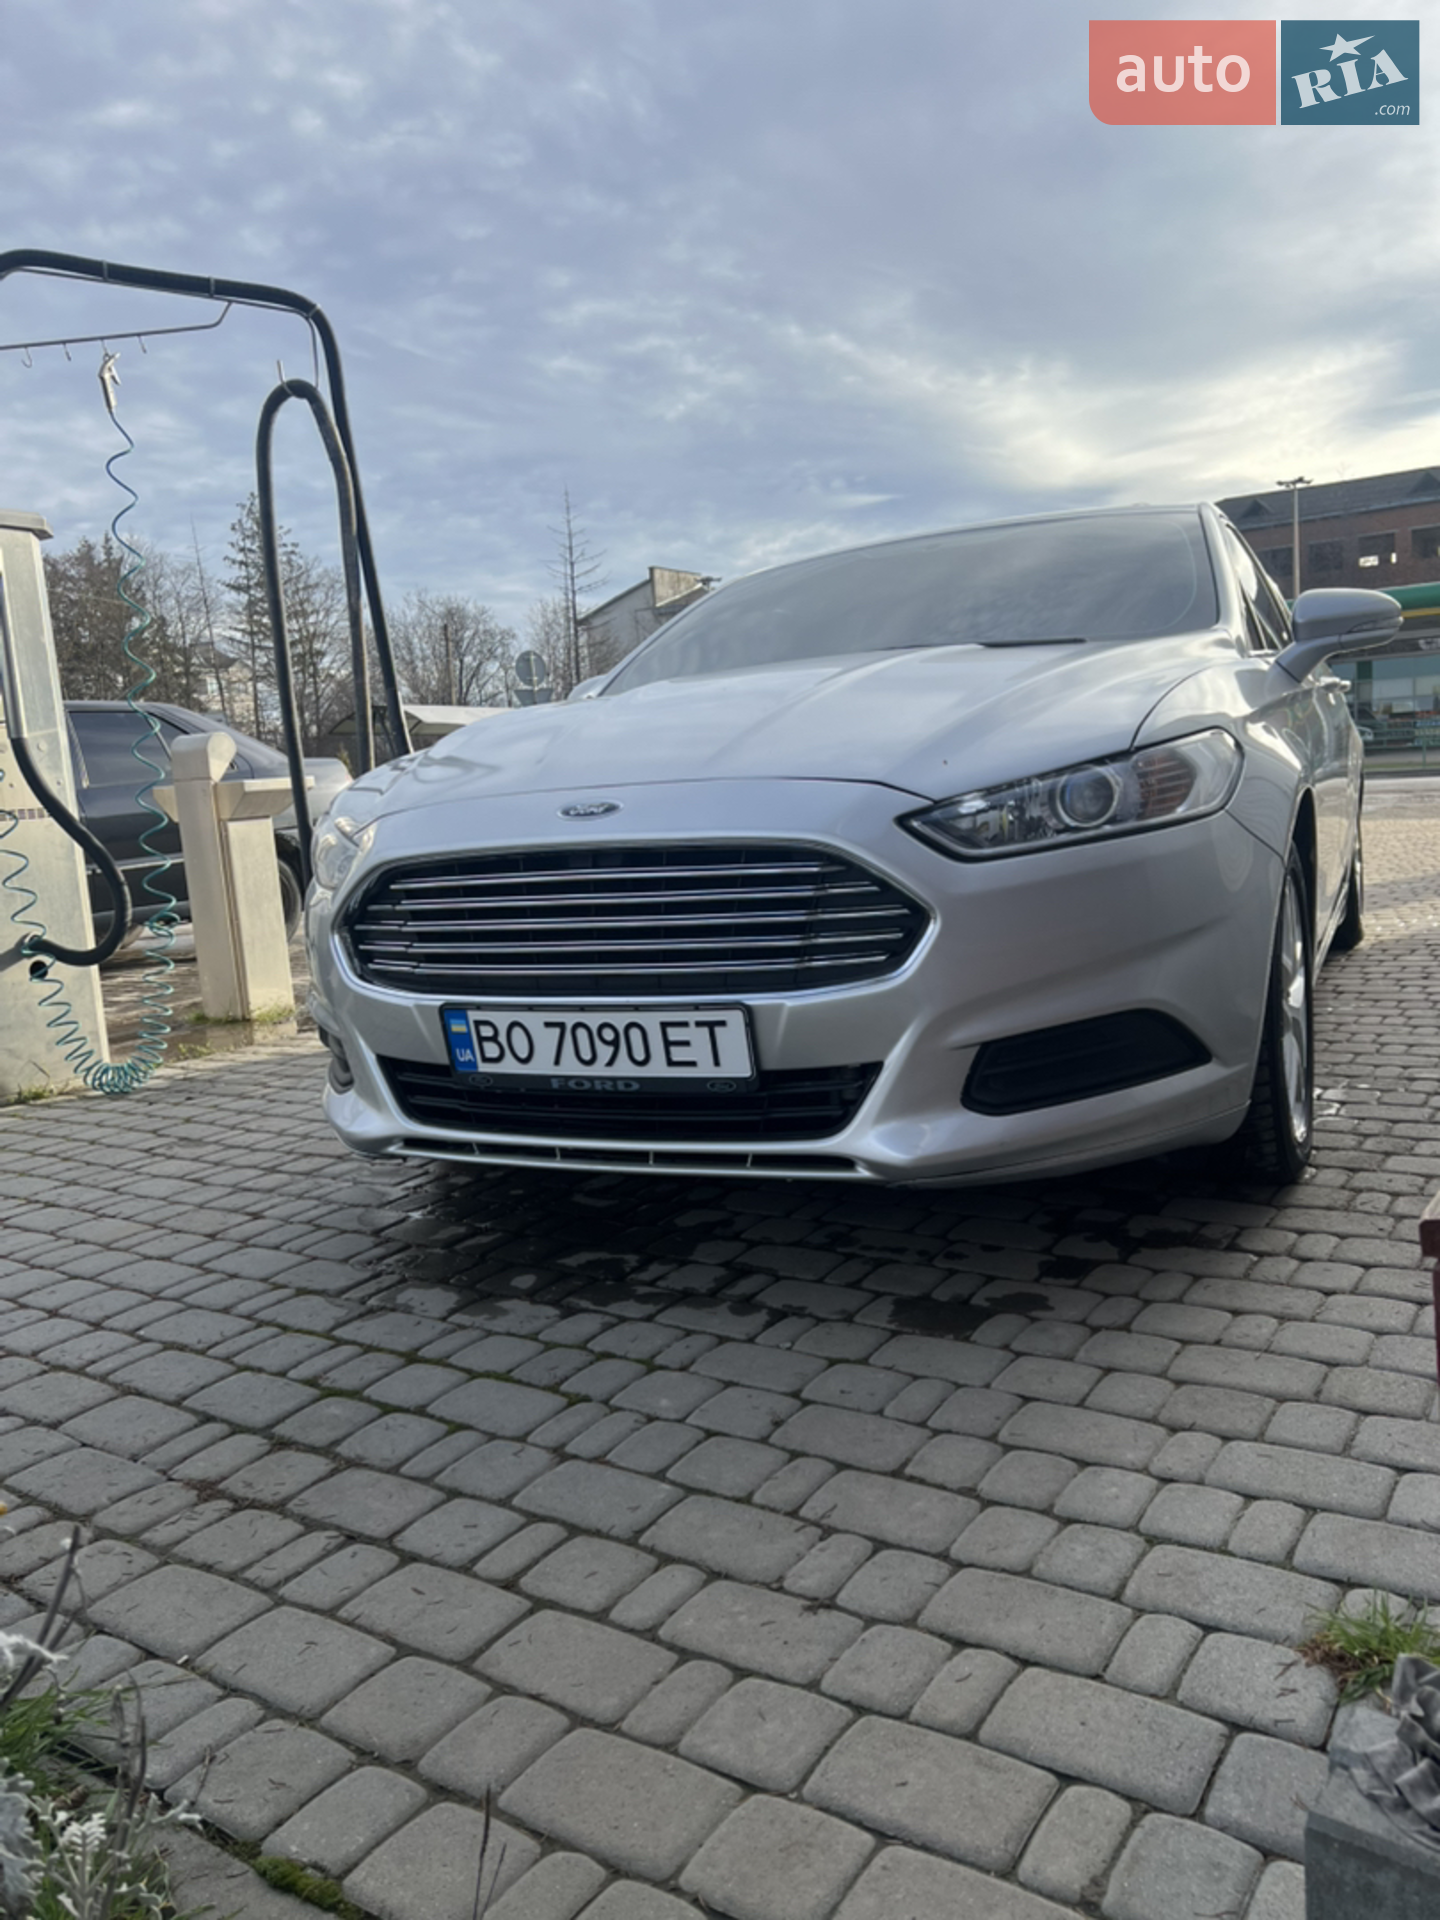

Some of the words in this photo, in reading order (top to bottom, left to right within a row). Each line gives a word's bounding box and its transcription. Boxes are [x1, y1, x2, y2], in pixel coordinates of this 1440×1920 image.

[473, 1020, 535, 1065] BO
[543, 1021, 651, 1067] 7090
[659, 1020, 727, 1067] ET
[456, 1048, 475, 1062] UA
[551, 1078, 640, 1092] FORD
